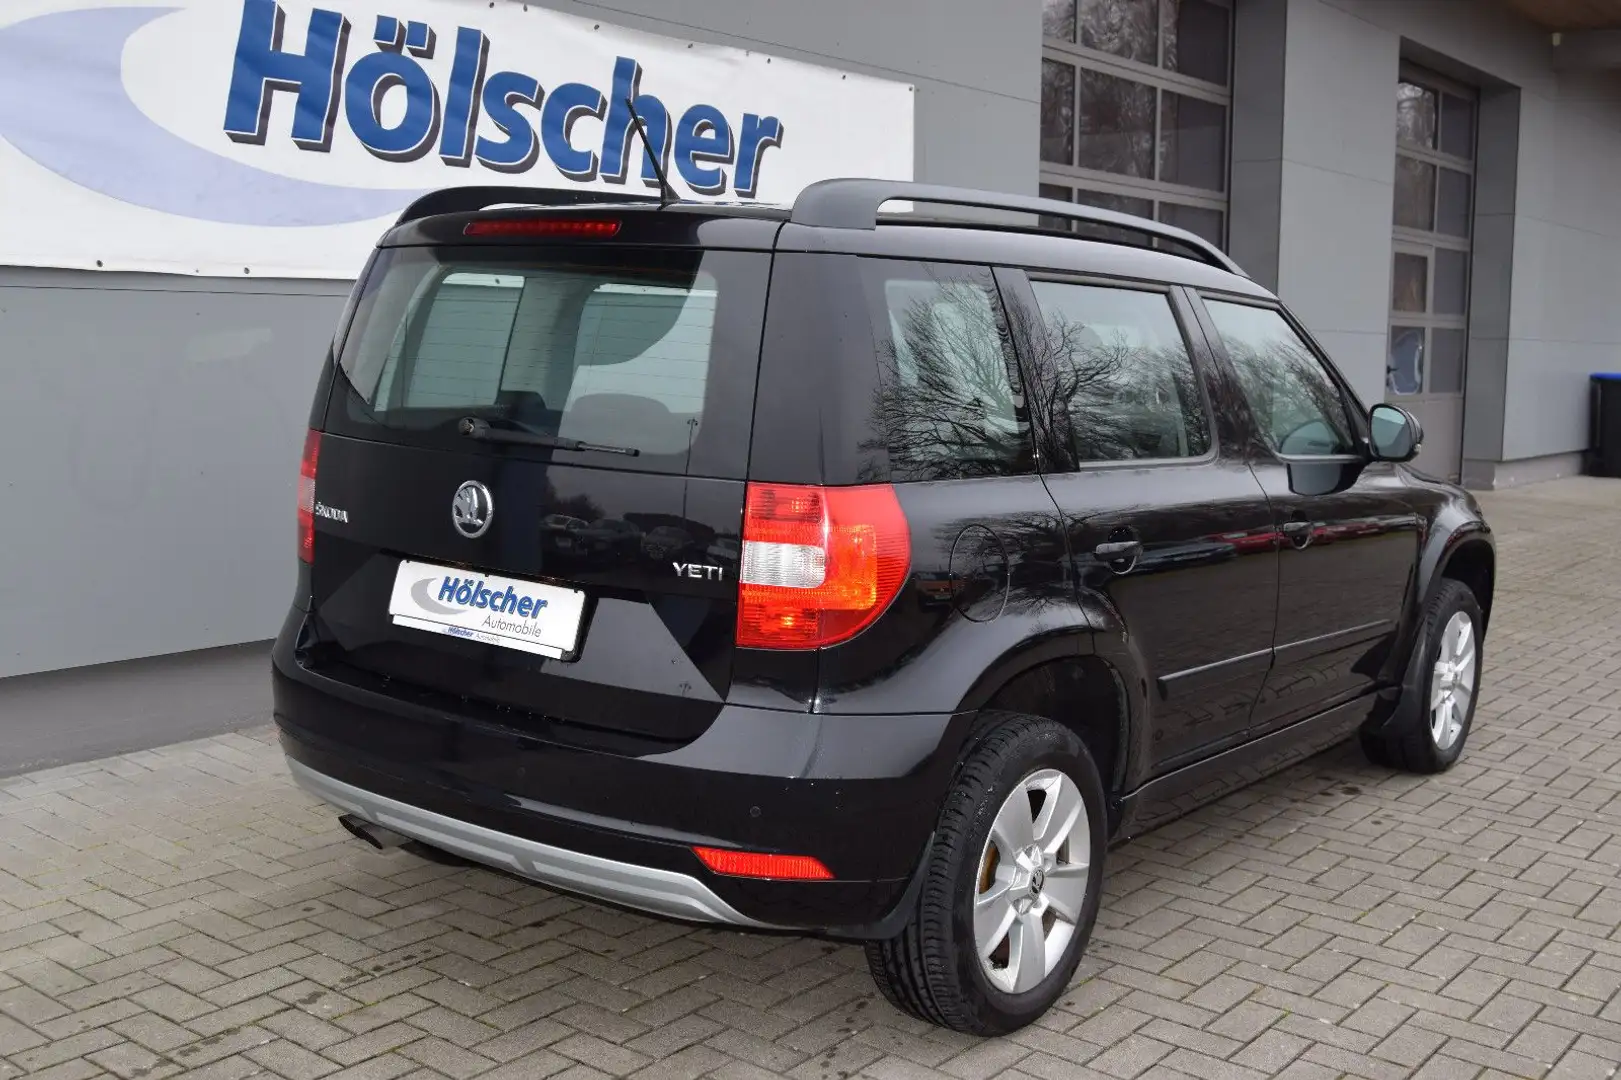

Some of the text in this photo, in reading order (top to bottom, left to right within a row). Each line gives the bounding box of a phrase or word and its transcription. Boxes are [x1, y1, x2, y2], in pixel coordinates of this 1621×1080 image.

[224, 0, 783, 198] Hölscher
[672, 562, 723, 581] YETI
[437, 575, 548, 619] Hölscher
[481, 614, 542, 638] Automobile
